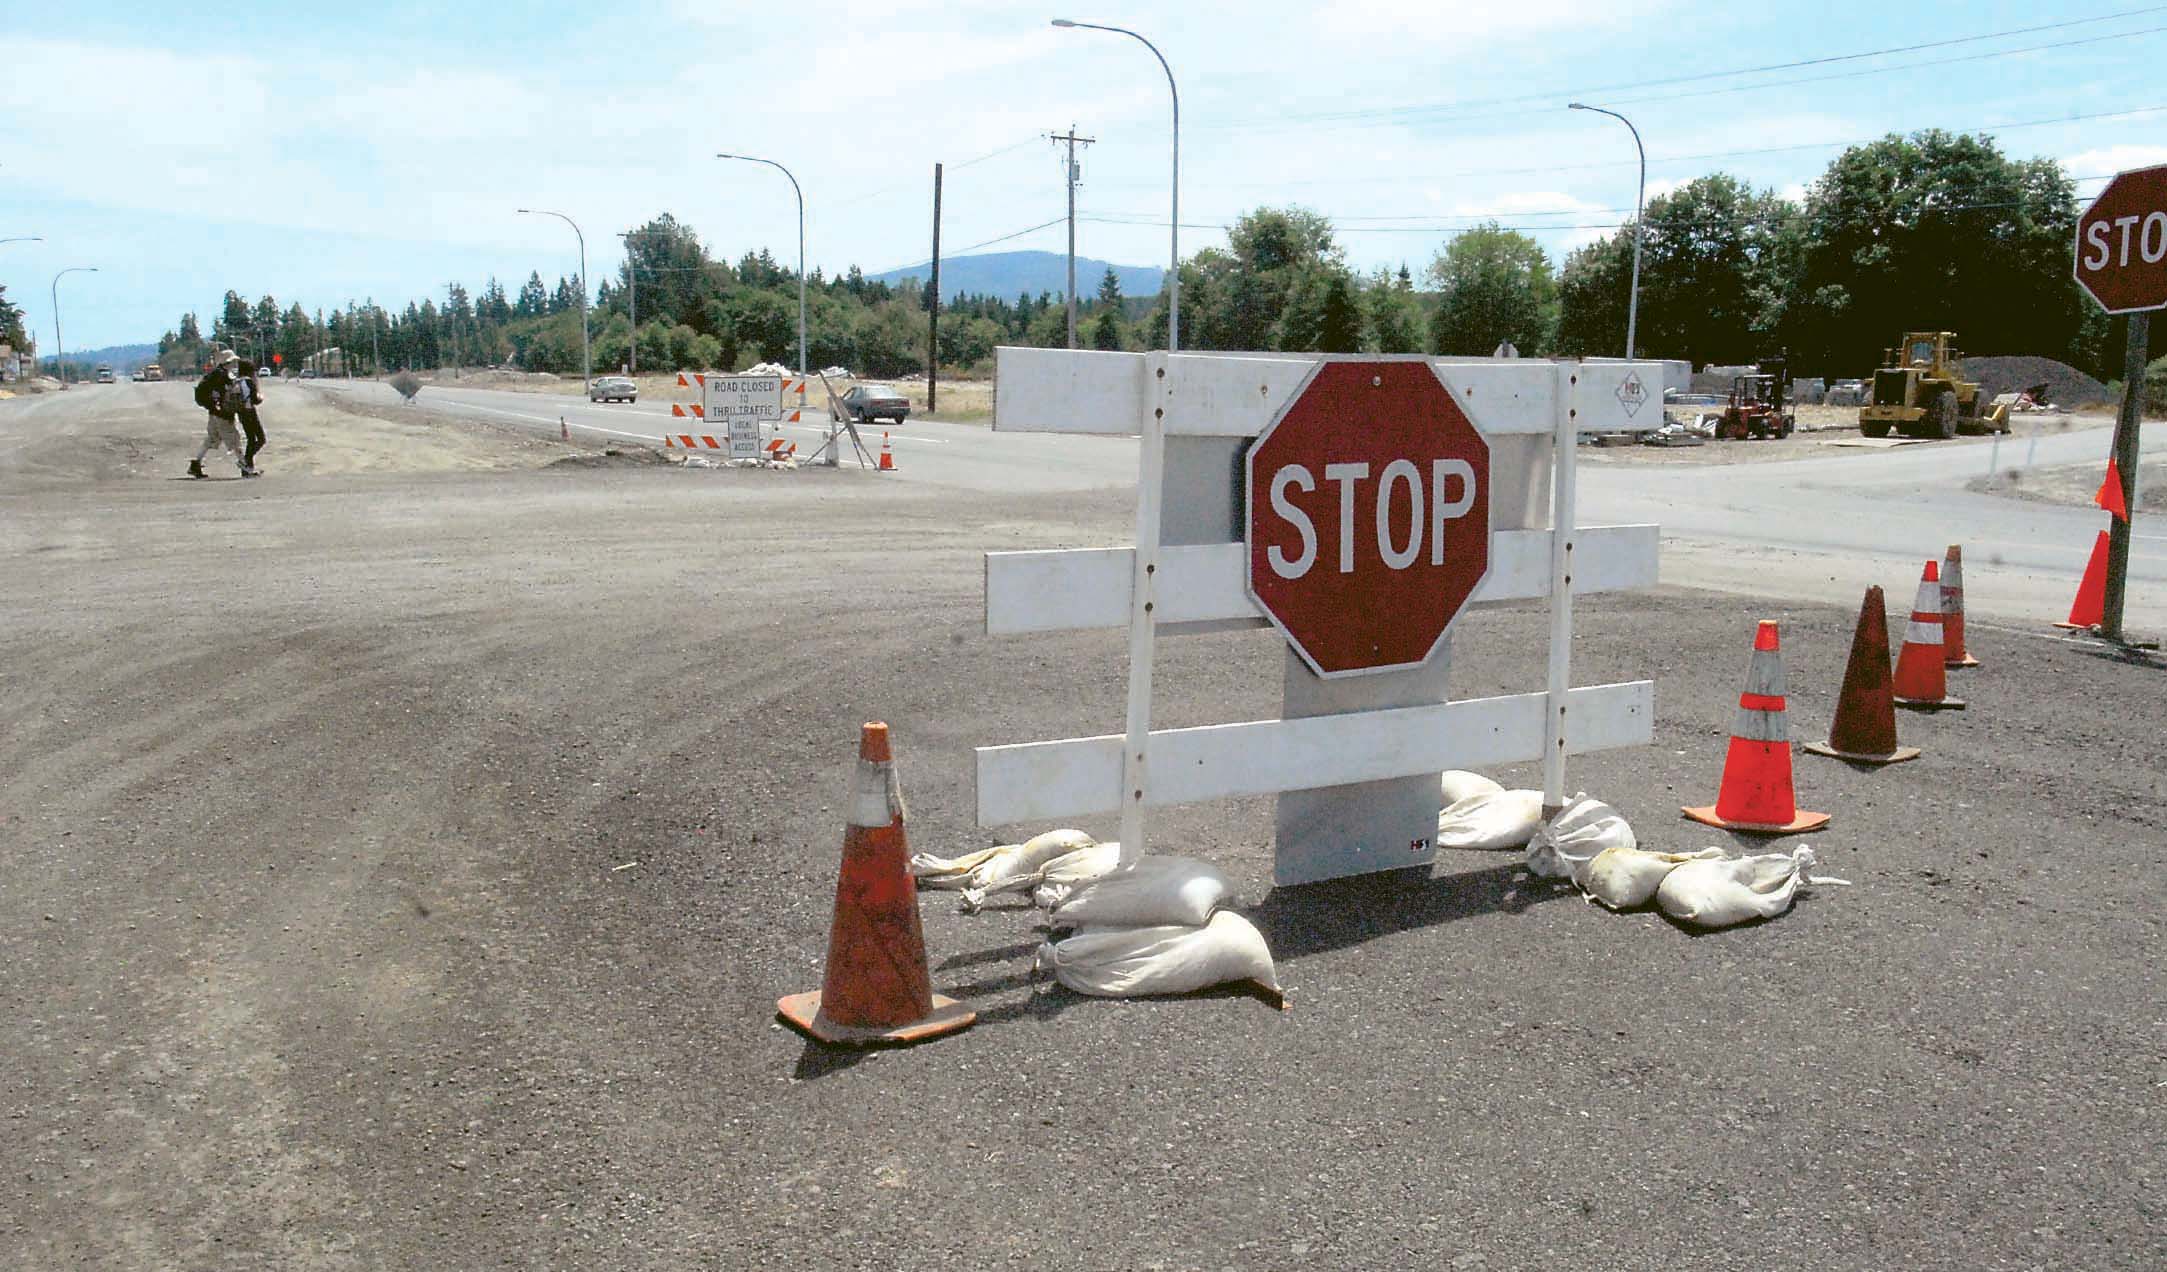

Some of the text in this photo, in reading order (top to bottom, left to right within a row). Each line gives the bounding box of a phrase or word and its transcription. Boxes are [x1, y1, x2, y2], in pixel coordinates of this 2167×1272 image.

[714, 381, 775, 392] ROAD CLOSED
[740, 394, 749, 404] TO
[713, 405, 773, 417] THRU TRAFFIC
[1267, 459, 1476, 579] STOP
